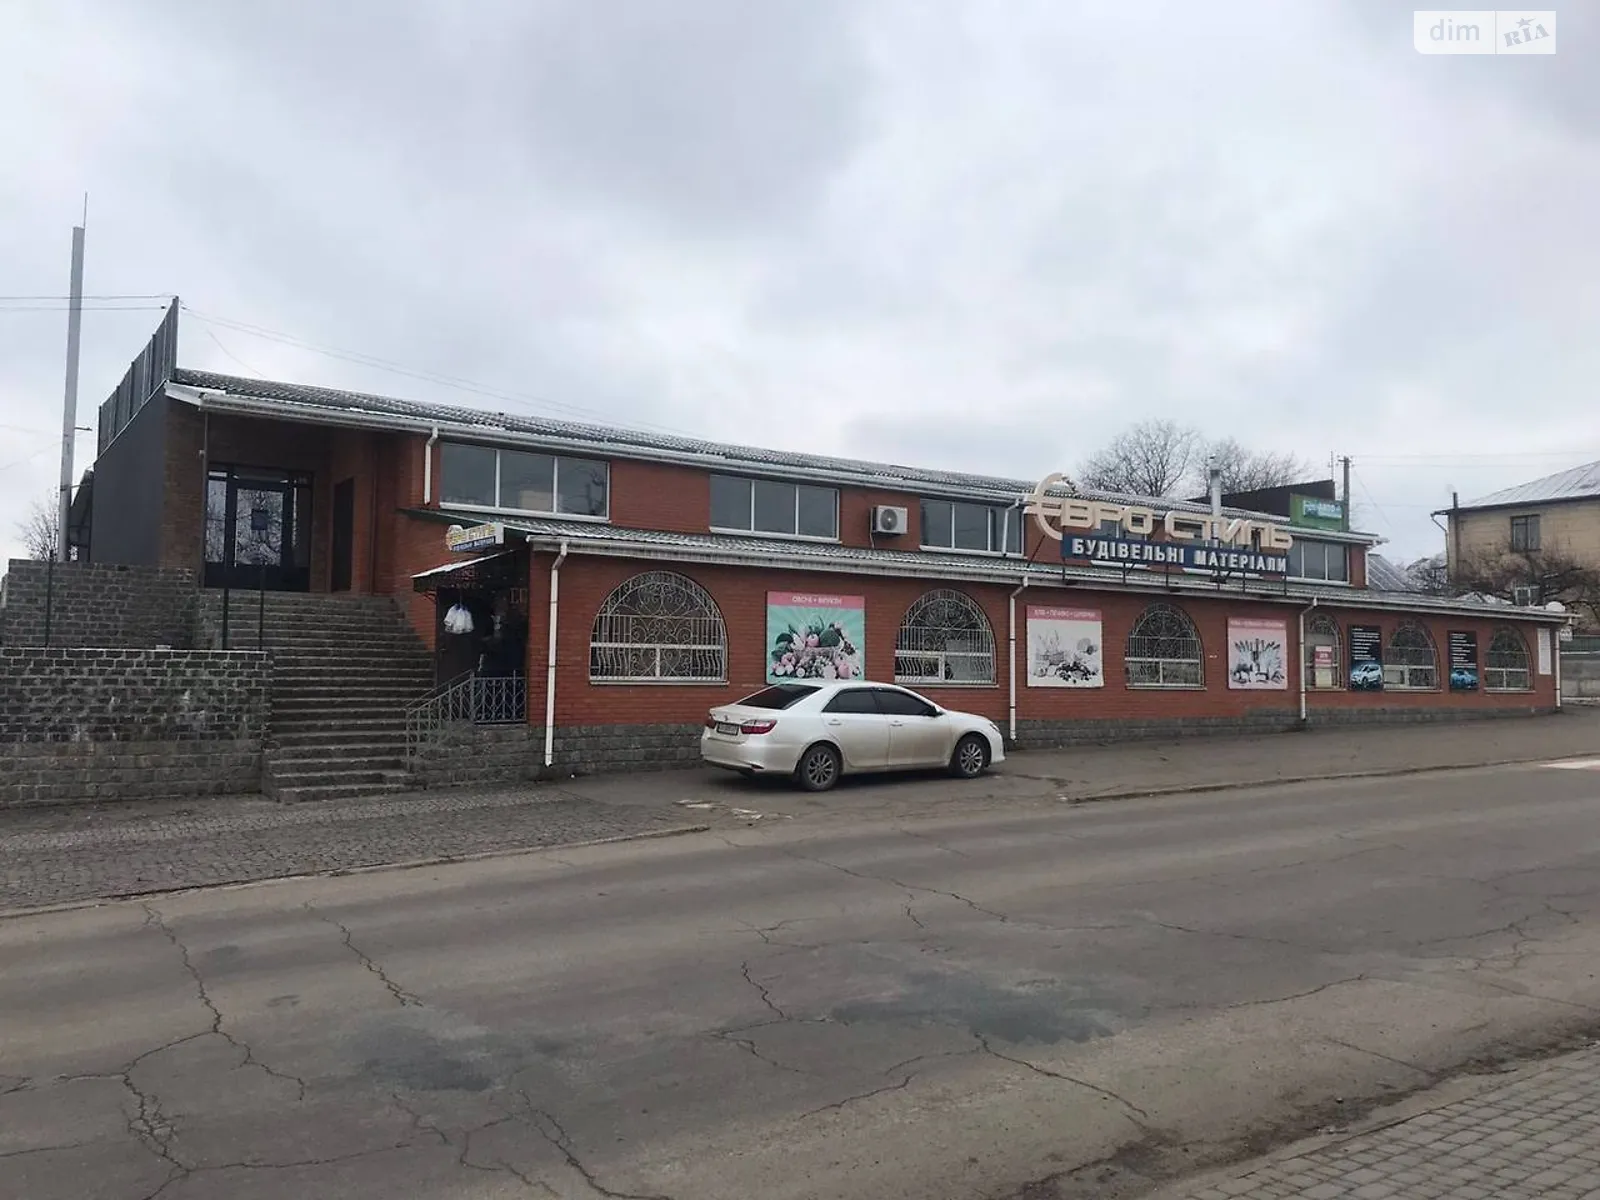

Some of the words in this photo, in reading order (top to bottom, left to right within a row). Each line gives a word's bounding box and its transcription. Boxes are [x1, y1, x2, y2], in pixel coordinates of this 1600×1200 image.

[1164, 509, 1294, 550] СТИЛЬ
[1071, 538, 1185, 564] БУДІВЕЛЬНІ
[1193, 548, 1287, 572] МАТЕРІАЛИ
